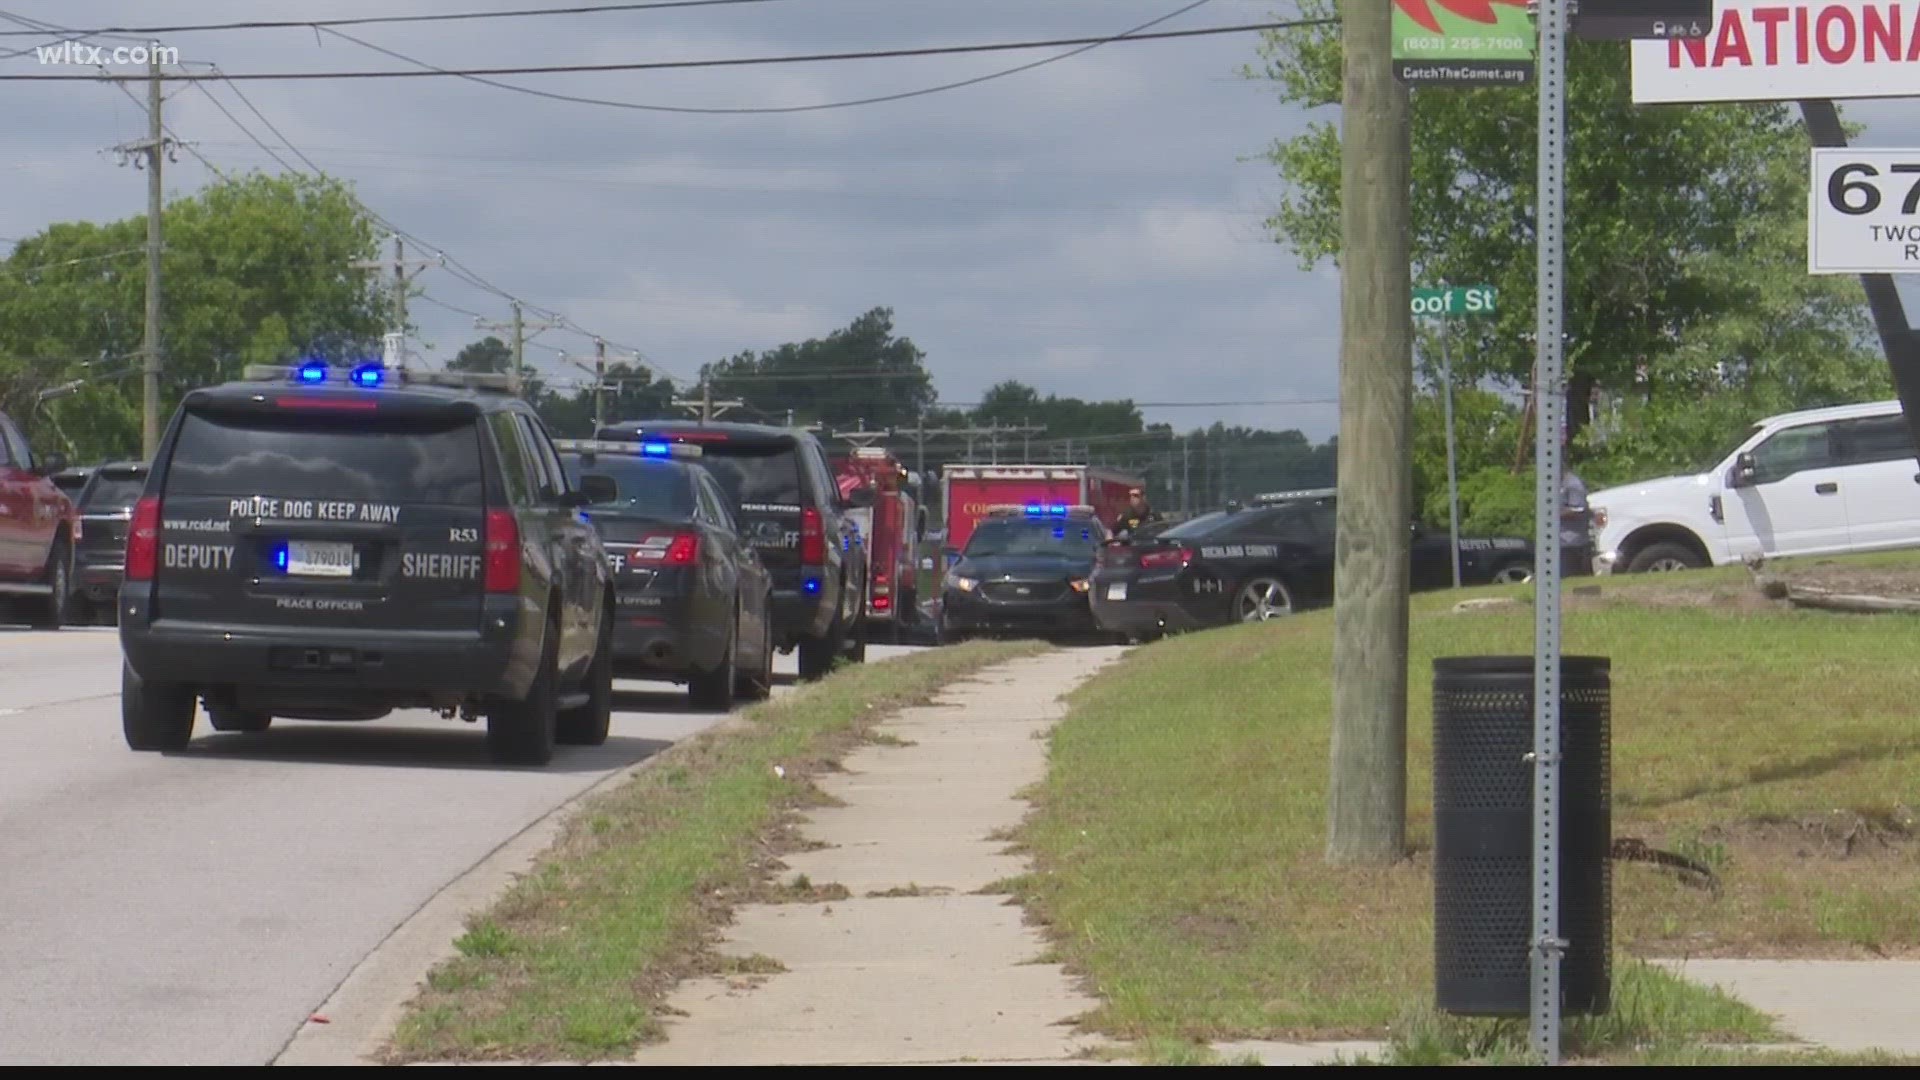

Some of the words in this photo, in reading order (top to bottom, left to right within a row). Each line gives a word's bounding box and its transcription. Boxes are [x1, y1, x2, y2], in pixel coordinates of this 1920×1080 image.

[1402, 66, 1525, 82] CatchTheComet.org
[1465, 289, 1493, 311] St
[229, 500, 279, 517] POLICE
[284, 501, 312, 518] DOG
[318, 502, 356, 520] KEEP
[360, 505, 400, 523] AWAY
[163, 519, 231, 532] www.rcsd.net
[450, 528, 479, 542] R53
[165, 544, 235, 569] DEPUTY
[403, 553, 481, 580] SHERIFF
[276, 599, 314, 609] PEACE
[316, 600, 364, 611] OFFICER
